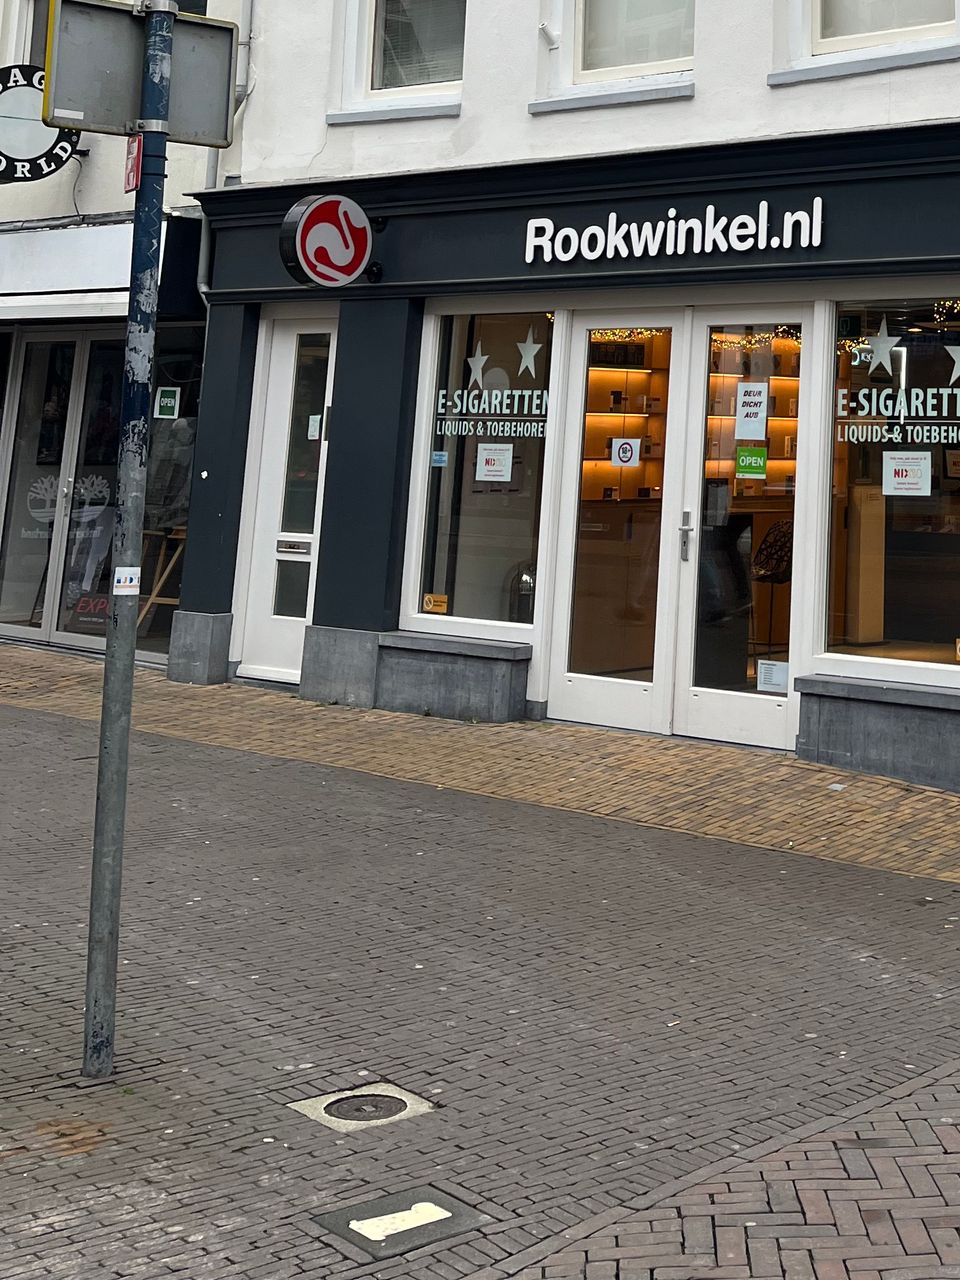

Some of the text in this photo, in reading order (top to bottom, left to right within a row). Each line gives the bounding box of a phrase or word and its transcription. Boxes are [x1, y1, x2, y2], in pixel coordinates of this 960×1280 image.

[524, 196, 823, 264] Rookwinkel.nl
[160, 397, 175, 407] OPEN
[437, 389, 549, 415] E-SIGARETTEN
[436, 421, 547, 438] LIQUIDS & TOEBEHORE
[837, 425, 889, 444] LIQUIDS
[892, 425, 903, 443] &
[739, 456, 764, 467] OPEN
